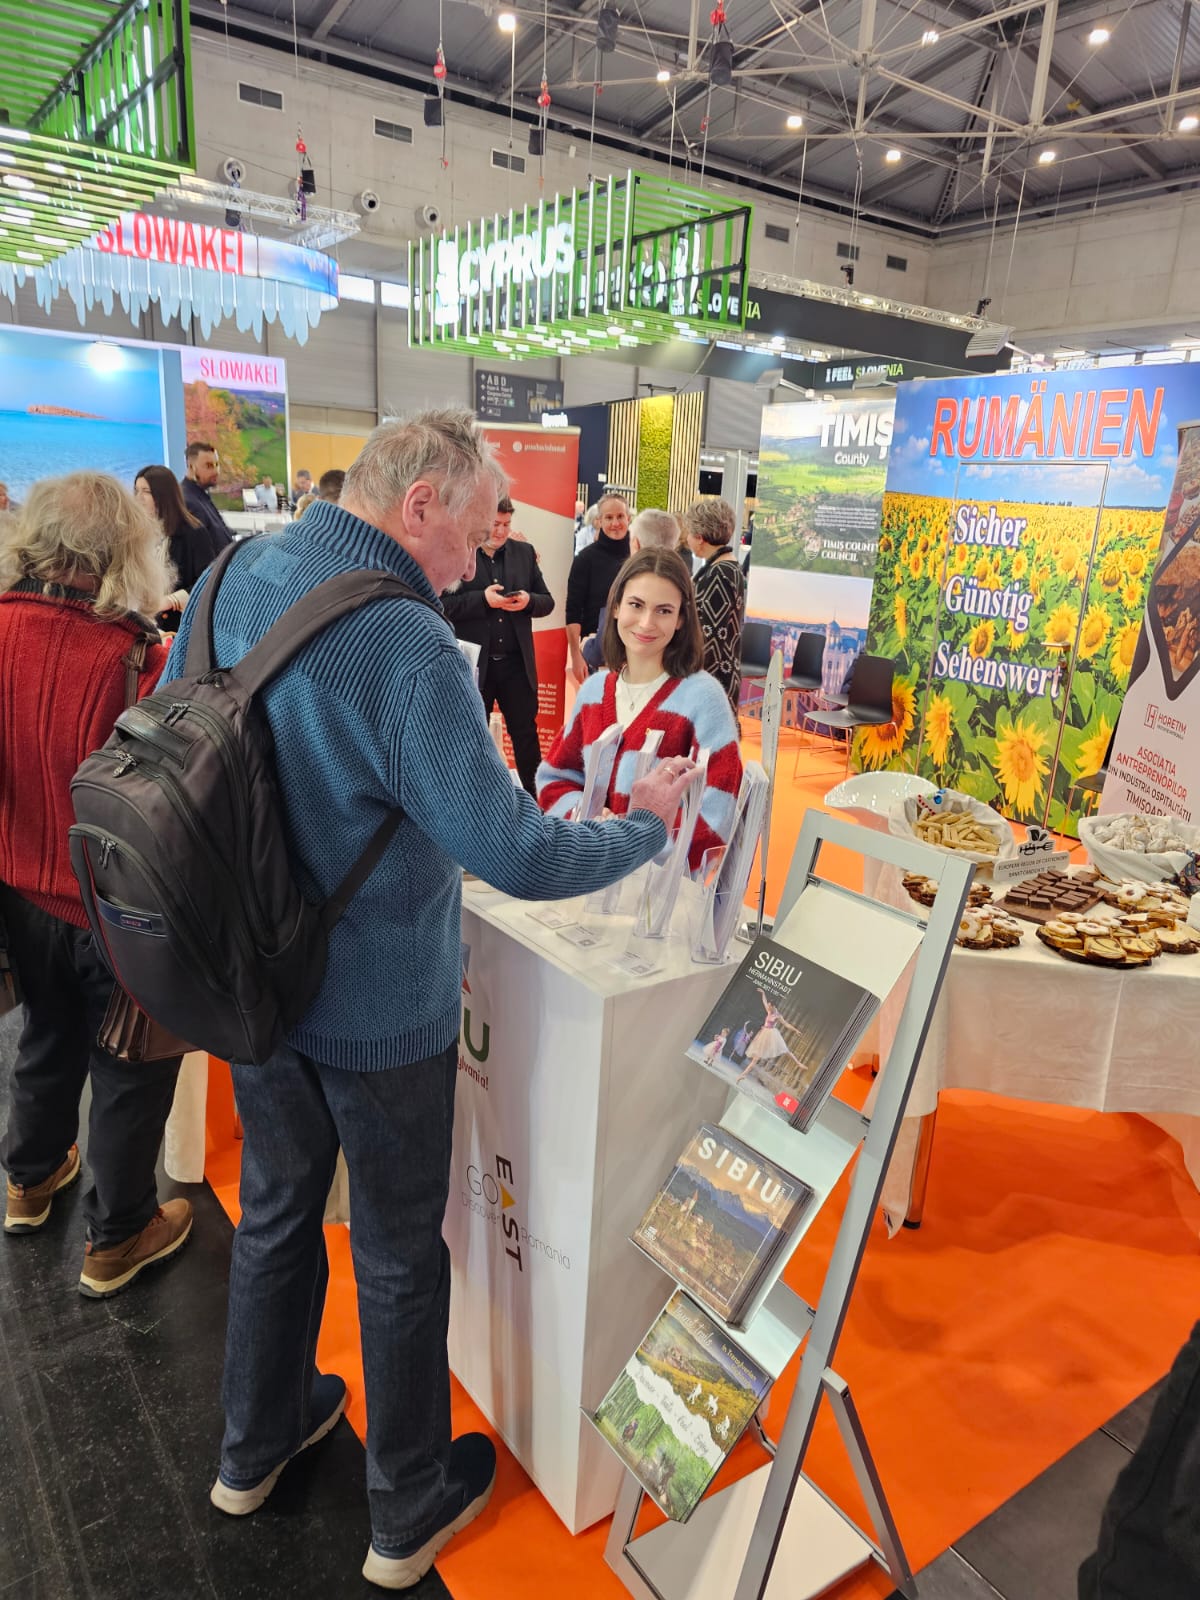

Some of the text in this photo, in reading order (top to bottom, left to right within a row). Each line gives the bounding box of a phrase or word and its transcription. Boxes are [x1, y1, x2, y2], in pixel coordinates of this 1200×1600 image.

[459, 222, 575, 297] CYPRUS
[200, 357, 278, 385] SLOWAKEI
[487, 374, 493, 385] A
[831, 366, 854, 382] FEEL
[929, 380, 1165, 458] RUMÄNIEN
[834, 451, 870, 467] County
[953, 505, 1027, 547] Sicher
[821, 550, 858, 562] COUNCIL
[945, 575, 1033, 632] Günstig
[934, 641, 1063, 699] Sehenswert
[1158, 713, 1187, 735] HORETIM
[1116, 752, 1188, 801] ANTREPRENORILOR
[1118, 771, 1150, 794] INDUSTRIA
[754, 951, 802, 986] SIBIU
[466, 1165, 499, 1205] GO
[698, 1137, 781, 1203] SIBIU
[520, 1227, 571, 1270] Romania
